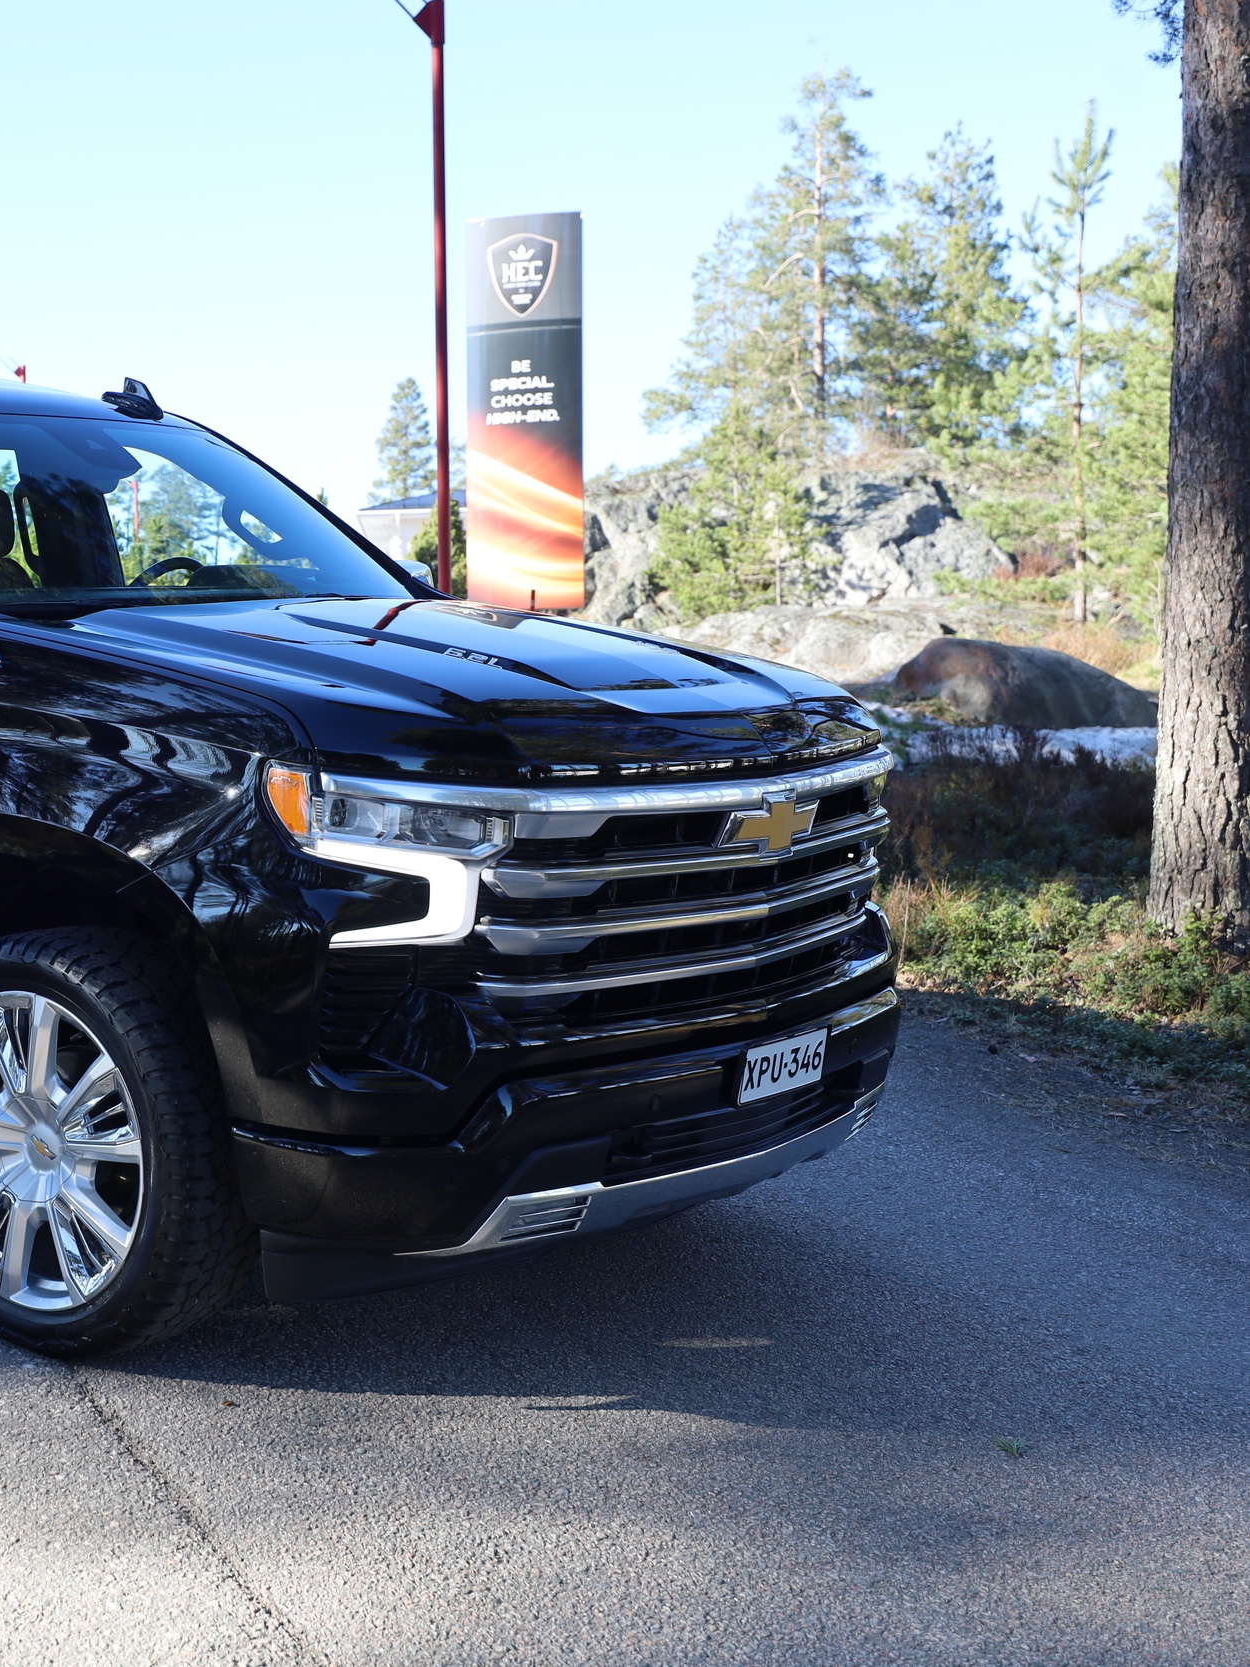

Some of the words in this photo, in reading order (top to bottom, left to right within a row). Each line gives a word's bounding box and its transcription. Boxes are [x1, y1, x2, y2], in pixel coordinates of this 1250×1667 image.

[501, 261, 543, 284] HEC
[511, 360, 531, 373] BE
[490, 376, 554, 392] SPECIAL.
[490, 393, 553, 408] CHOOSE
[443, 647, 503, 669] 6.2L
[743, 1040, 824, 1092] XPU-346
